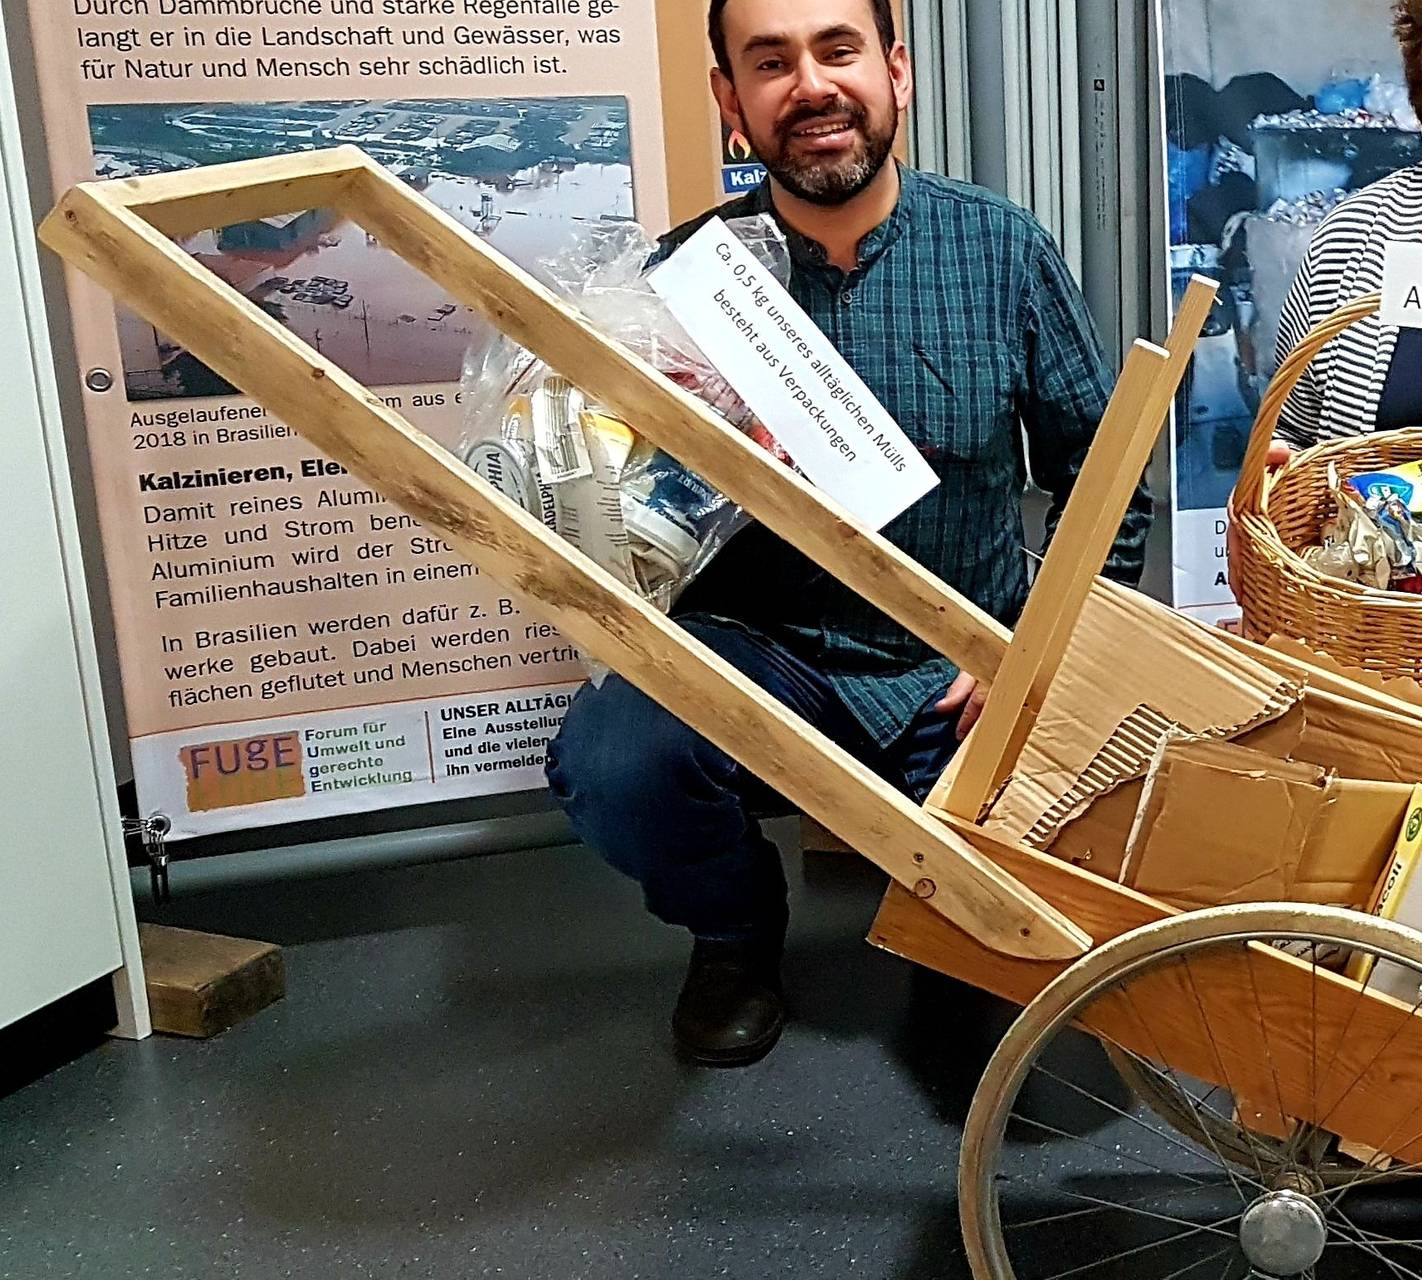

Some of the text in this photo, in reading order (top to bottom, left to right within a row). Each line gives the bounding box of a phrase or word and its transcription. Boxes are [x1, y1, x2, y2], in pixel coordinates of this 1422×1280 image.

[74, 0, 149, 15] Durch
[330, 0, 374, 14] und
[382, 0, 455, 14] starke
[587, 0, 620, 18] ge-
[77, 25, 620, 51] langt er in die Landschaft und Gewässer, was
[80, 55, 567, 79] für Natur und Mensch sehr schädlich ist.
[715, 243, 906, 472] Ca. 0,5 kg unseres alltäglichen Mülls
[713, 289, 857, 462] besteht aus Verpackungen
[412, 393, 445, 407] aus
[134, 431, 186, 449] 2018
[193, 431, 210, 445] in
[139, 465, 293, 491] Kalzinieren,
[144, 502, 216, 523] Damit
[230, 496, 303, 516] reines
[148, 533, 207, 552] Hitze
[225, 524, 268, 544] und
[284, 520, 353, 538] Strom
[152, 554, 275, 580] Aluminium
[291, 545, 339, 565] wird
[357, 543, 393, 559] der
[155, 563, 479, 608] Familienhaushalten in einem
[162, 598, 520, 652] In Brasilien werden dafür z. B.
[164, 657, 234, 680] werke
[250, 645, 336, 673] gebaut.
[352, 635, 416, 657] Dabei
[431, 628, 510, 649] werden
[169, 683, 252, 707] flächen
[261, 669, 347, 699] geflutet
[353, 664, 393, 684] und
[402, 654, 511, 678] Menschen
[441, 703, 499, 721] UNSER
[305, 721, 387, 741] Forum für
[443, 727, 477, 740] Eine
[307, 736, 406, 757] Umwelt und
[445, 737, 550, 758] und die vielen
[309, 756, 383, 778] gerechte
[311, 770, 413, 793] Entwicklung
